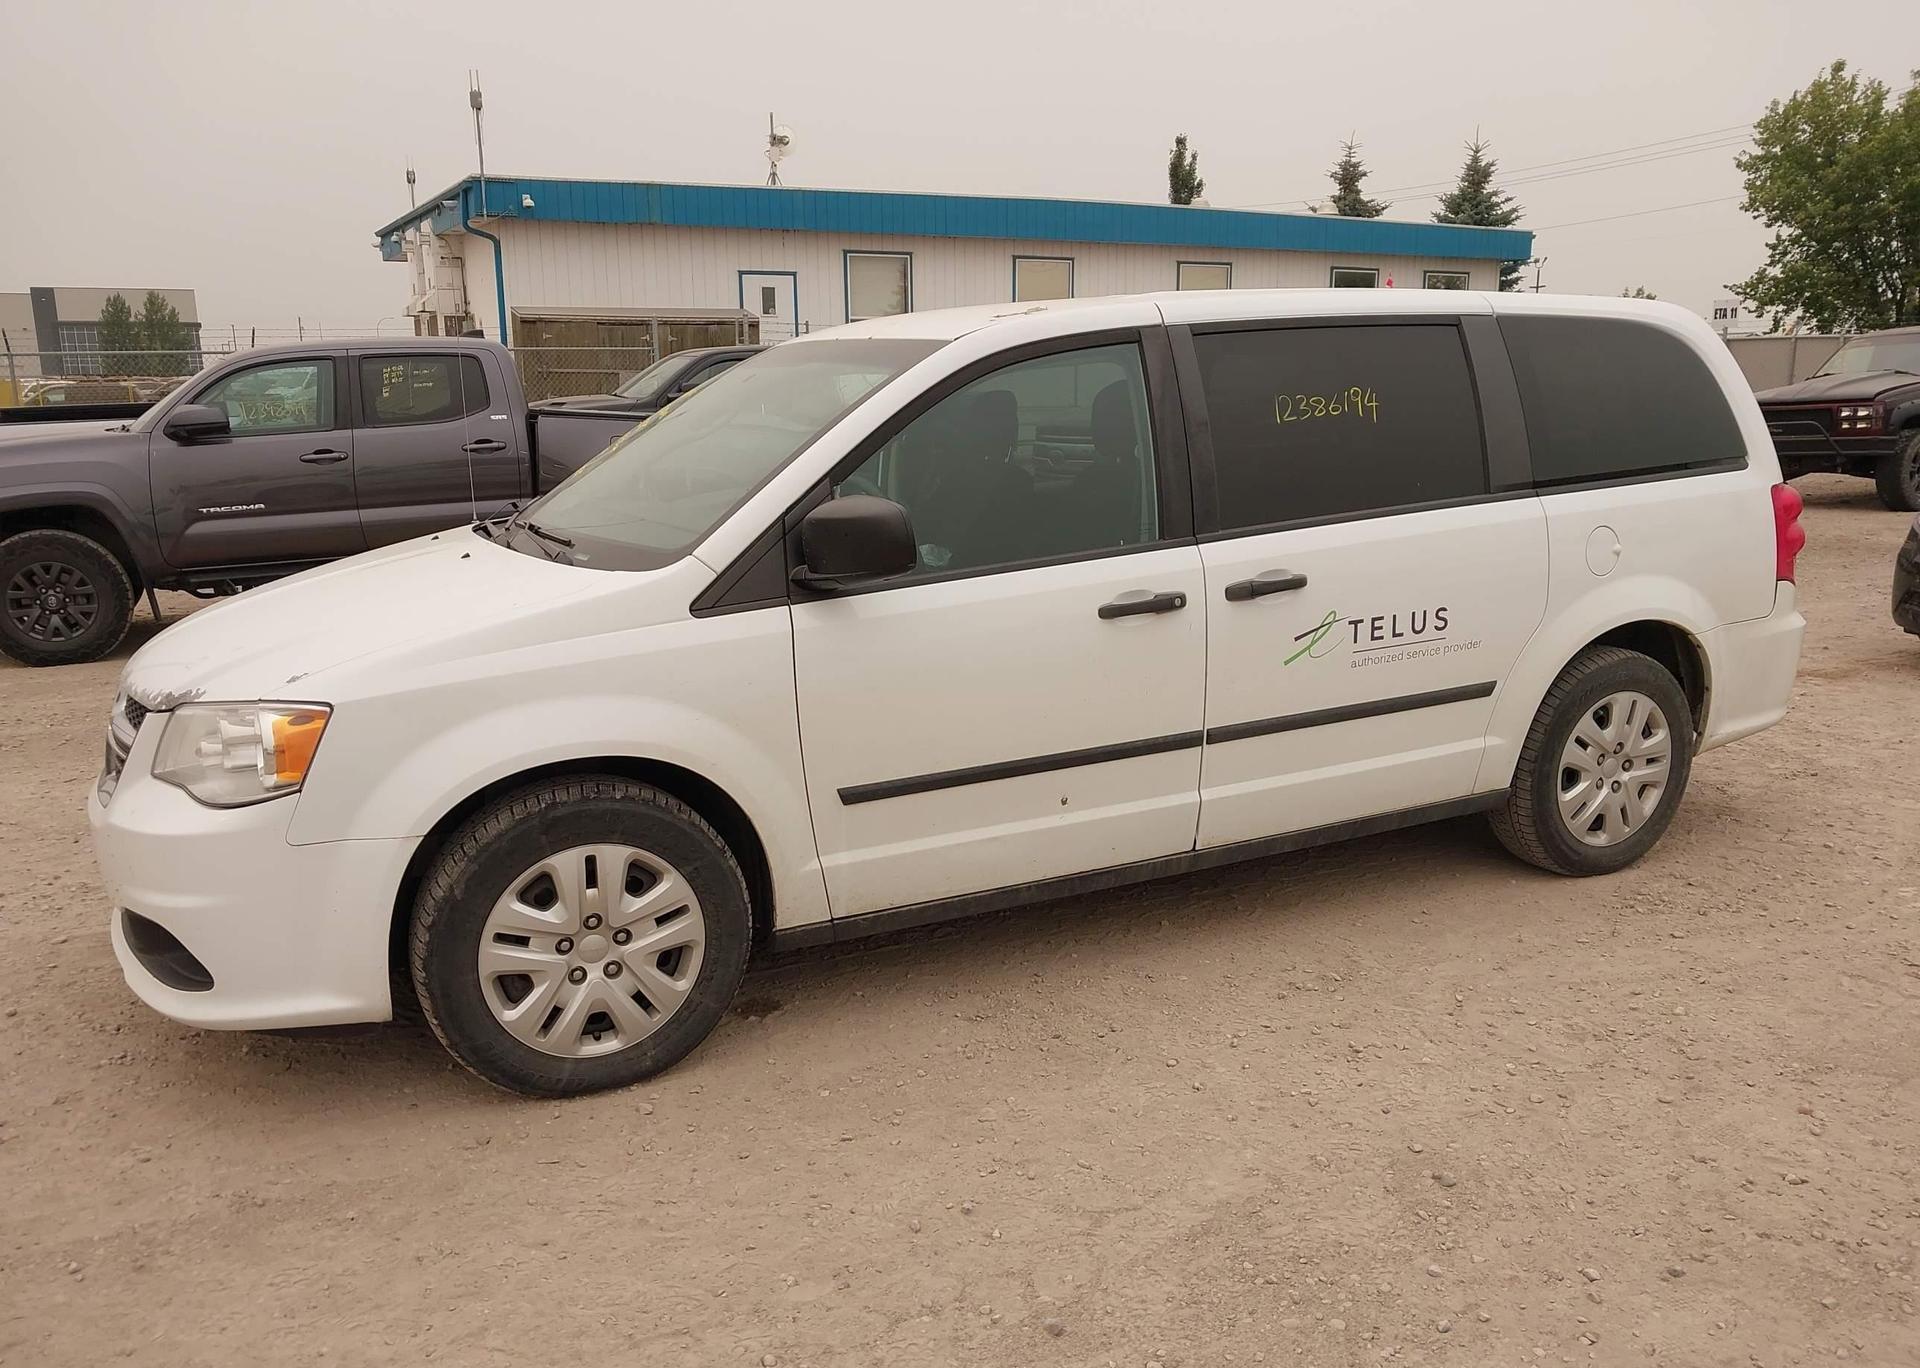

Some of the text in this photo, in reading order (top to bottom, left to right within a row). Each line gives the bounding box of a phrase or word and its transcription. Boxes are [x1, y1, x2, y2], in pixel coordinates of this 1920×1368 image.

[1714, 307, 1738, 320] ETA 11
[1275, 387, 1380, 424] 12386194
[198, 503, 266, 514] TACOMA
[1348, 607, 1449, 645] TELUS
[1350, 640, 1482, 668] authorized service provider
